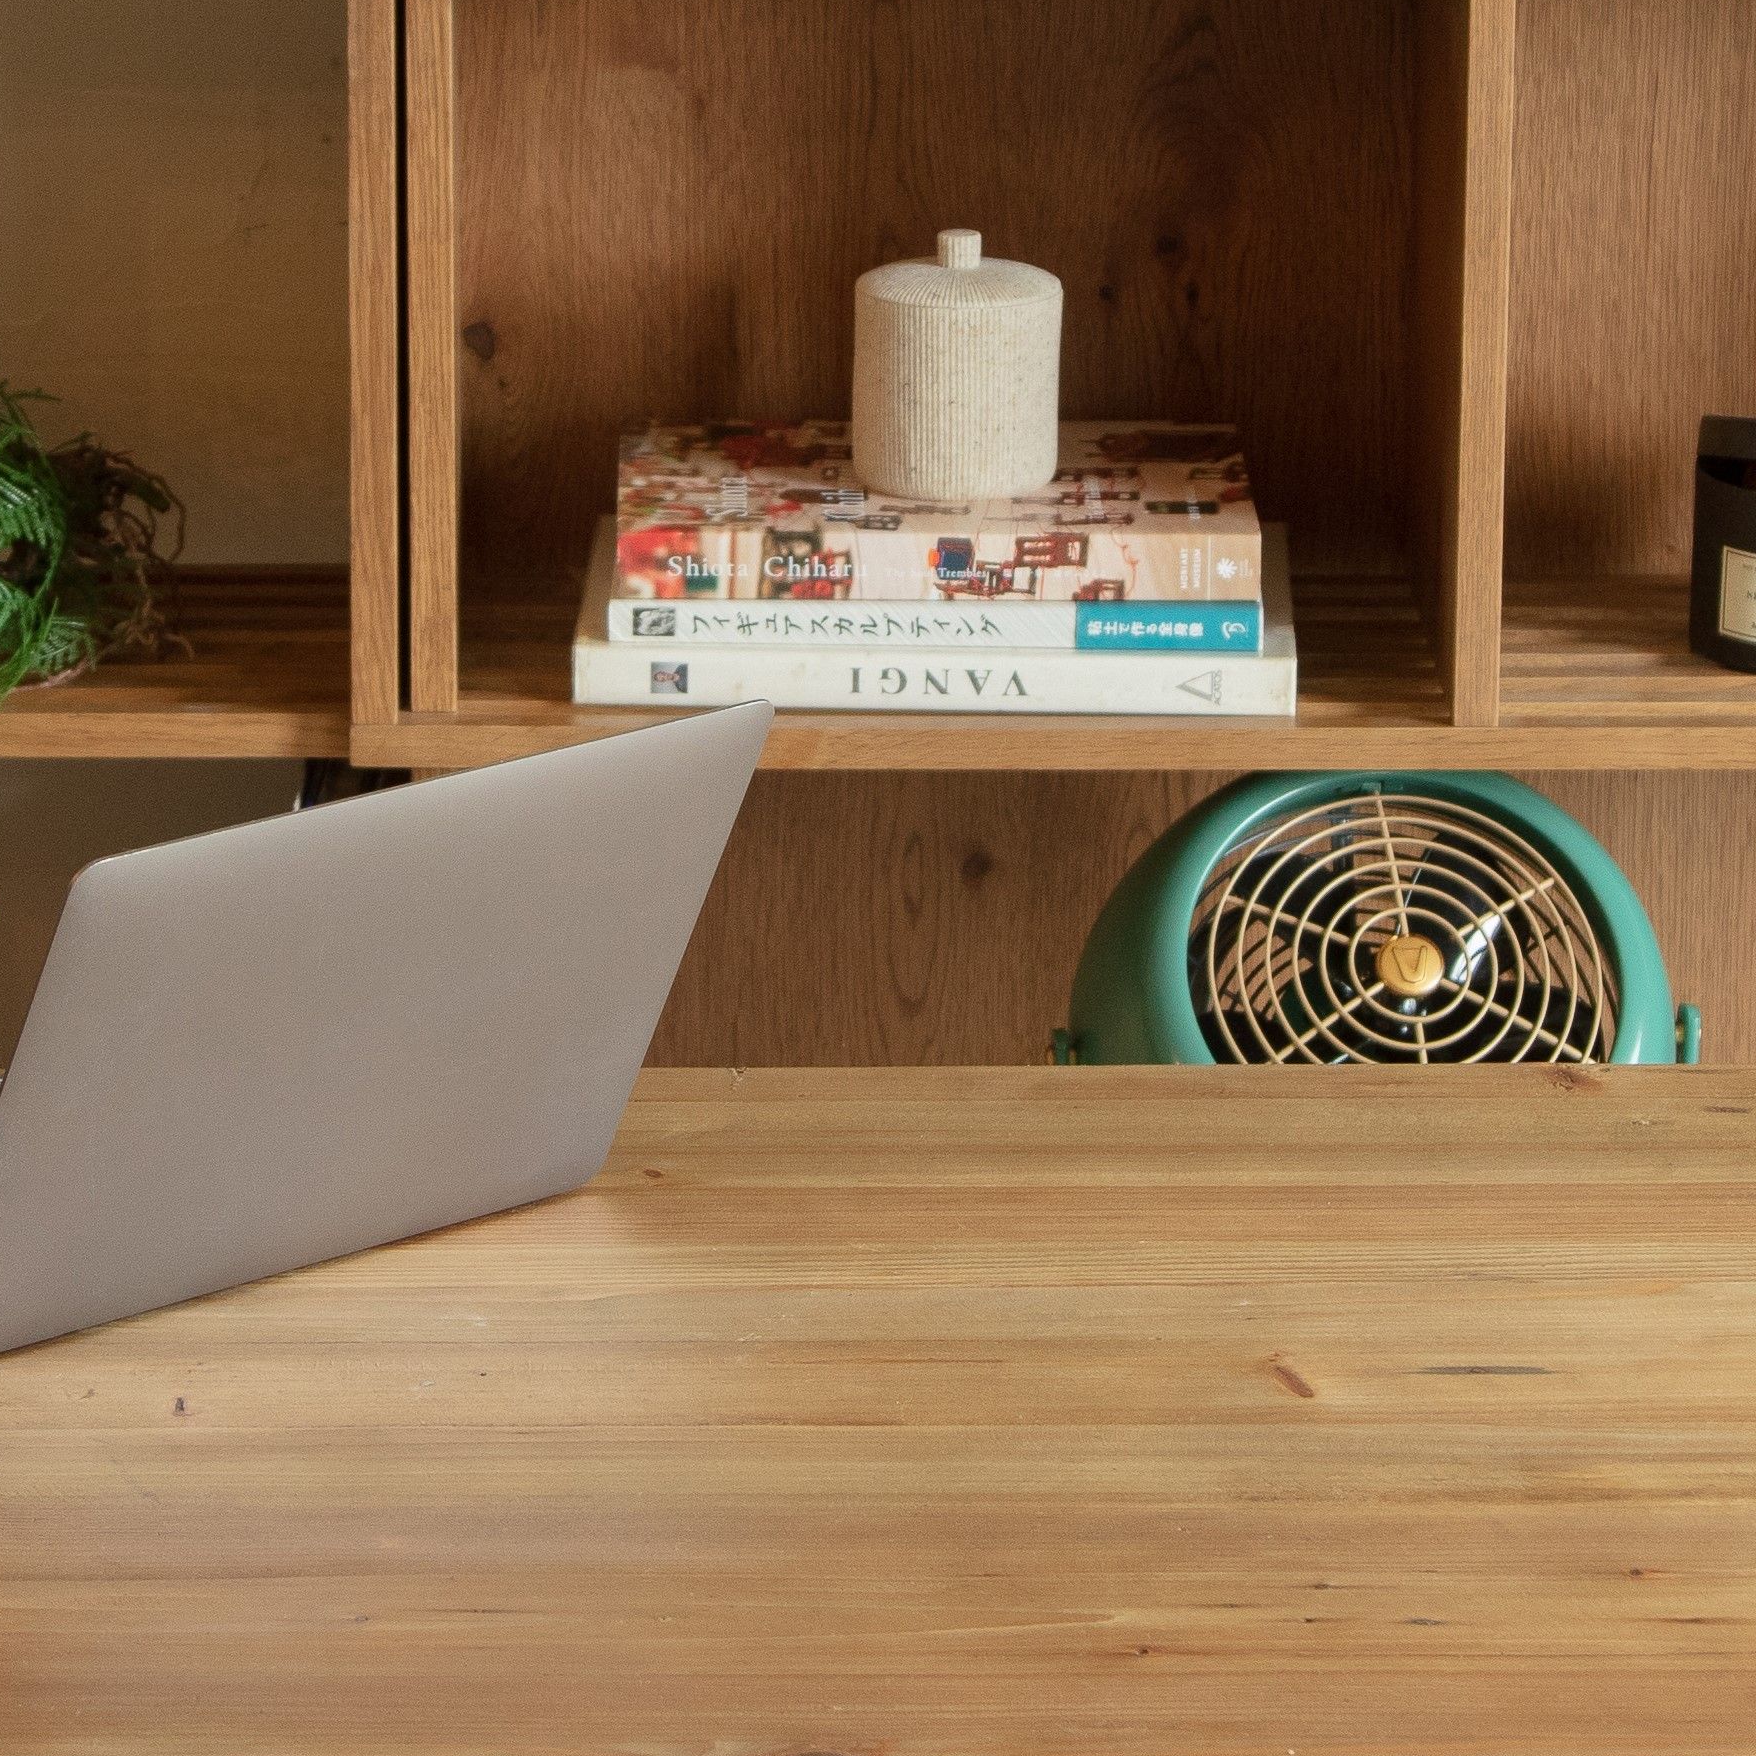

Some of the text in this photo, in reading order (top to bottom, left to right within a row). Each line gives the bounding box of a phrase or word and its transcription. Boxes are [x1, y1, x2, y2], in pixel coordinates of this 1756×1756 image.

[667, 555, 748, 578] Shiota
[764, 555, 868, 578] Chiharu
[692, 612, 1003, 638] フィギュアスカルプティング
[849, 667, 1029, 697] VANGI
